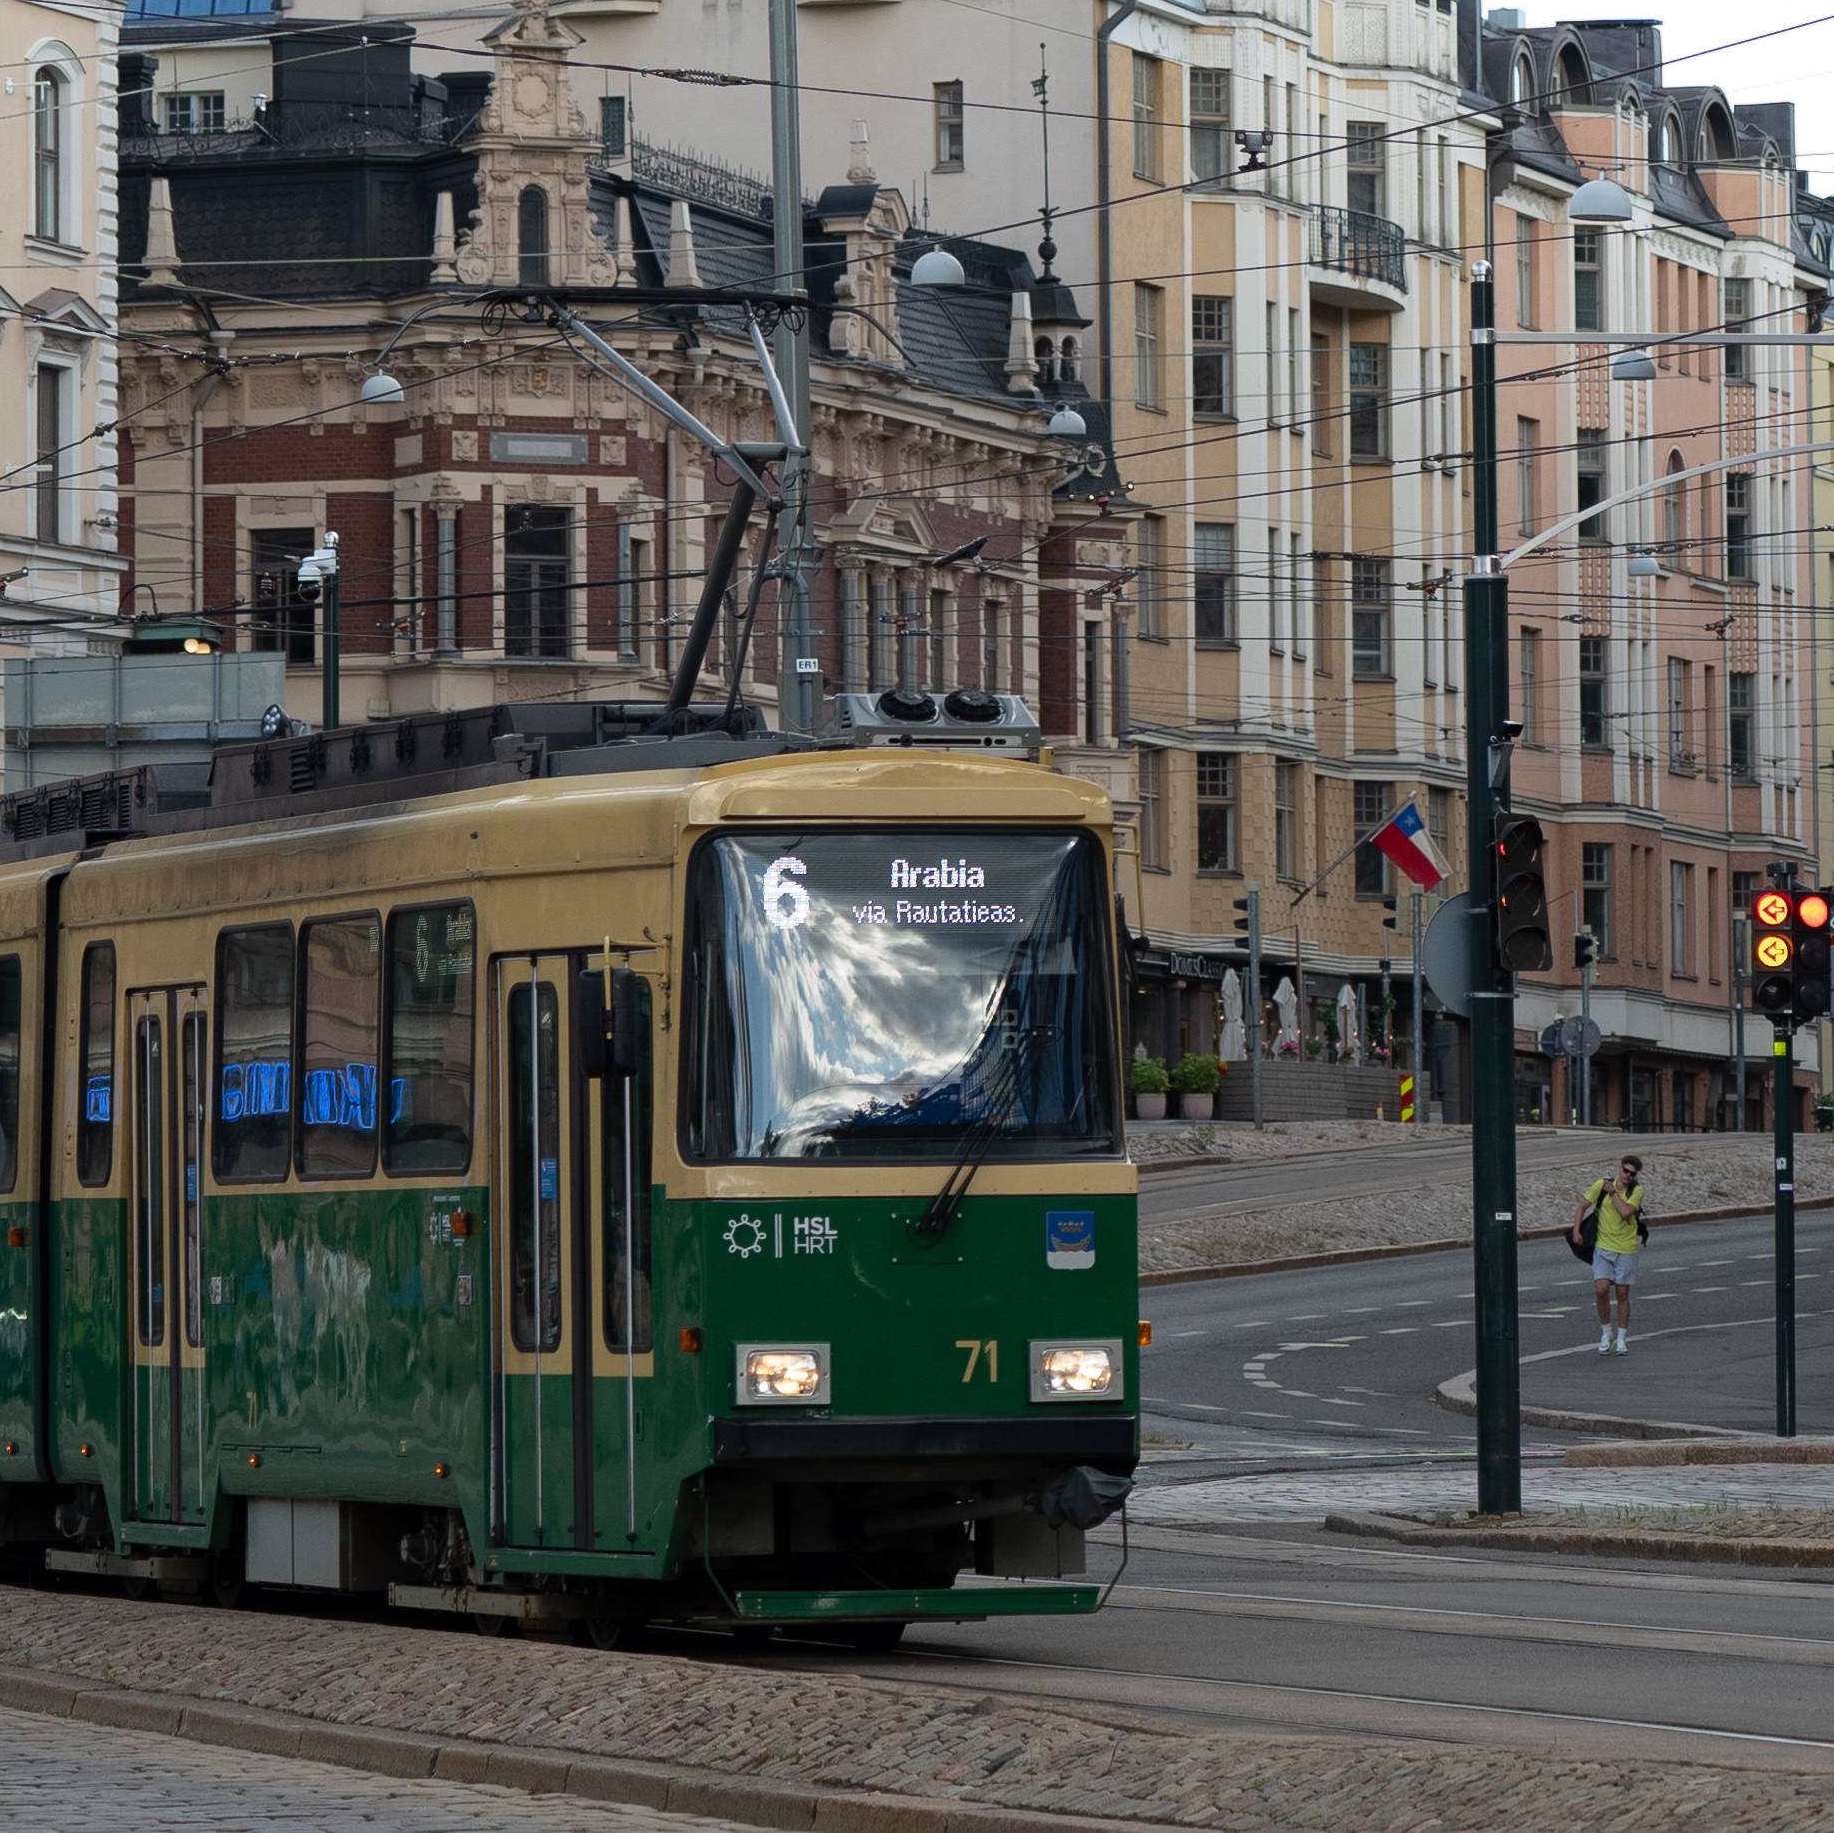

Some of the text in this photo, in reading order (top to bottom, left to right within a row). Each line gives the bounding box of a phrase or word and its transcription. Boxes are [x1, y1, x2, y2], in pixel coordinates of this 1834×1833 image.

[799, 661, 816, 669] ER1
[763, 856, 985, 929] 6 Arabia
[853, 901, 888, 924] via
[794, 1217, 838, 1235] HSL
[794, 1236, 838, 1254] HRT
[955, 1340, 998, 1383] 71
